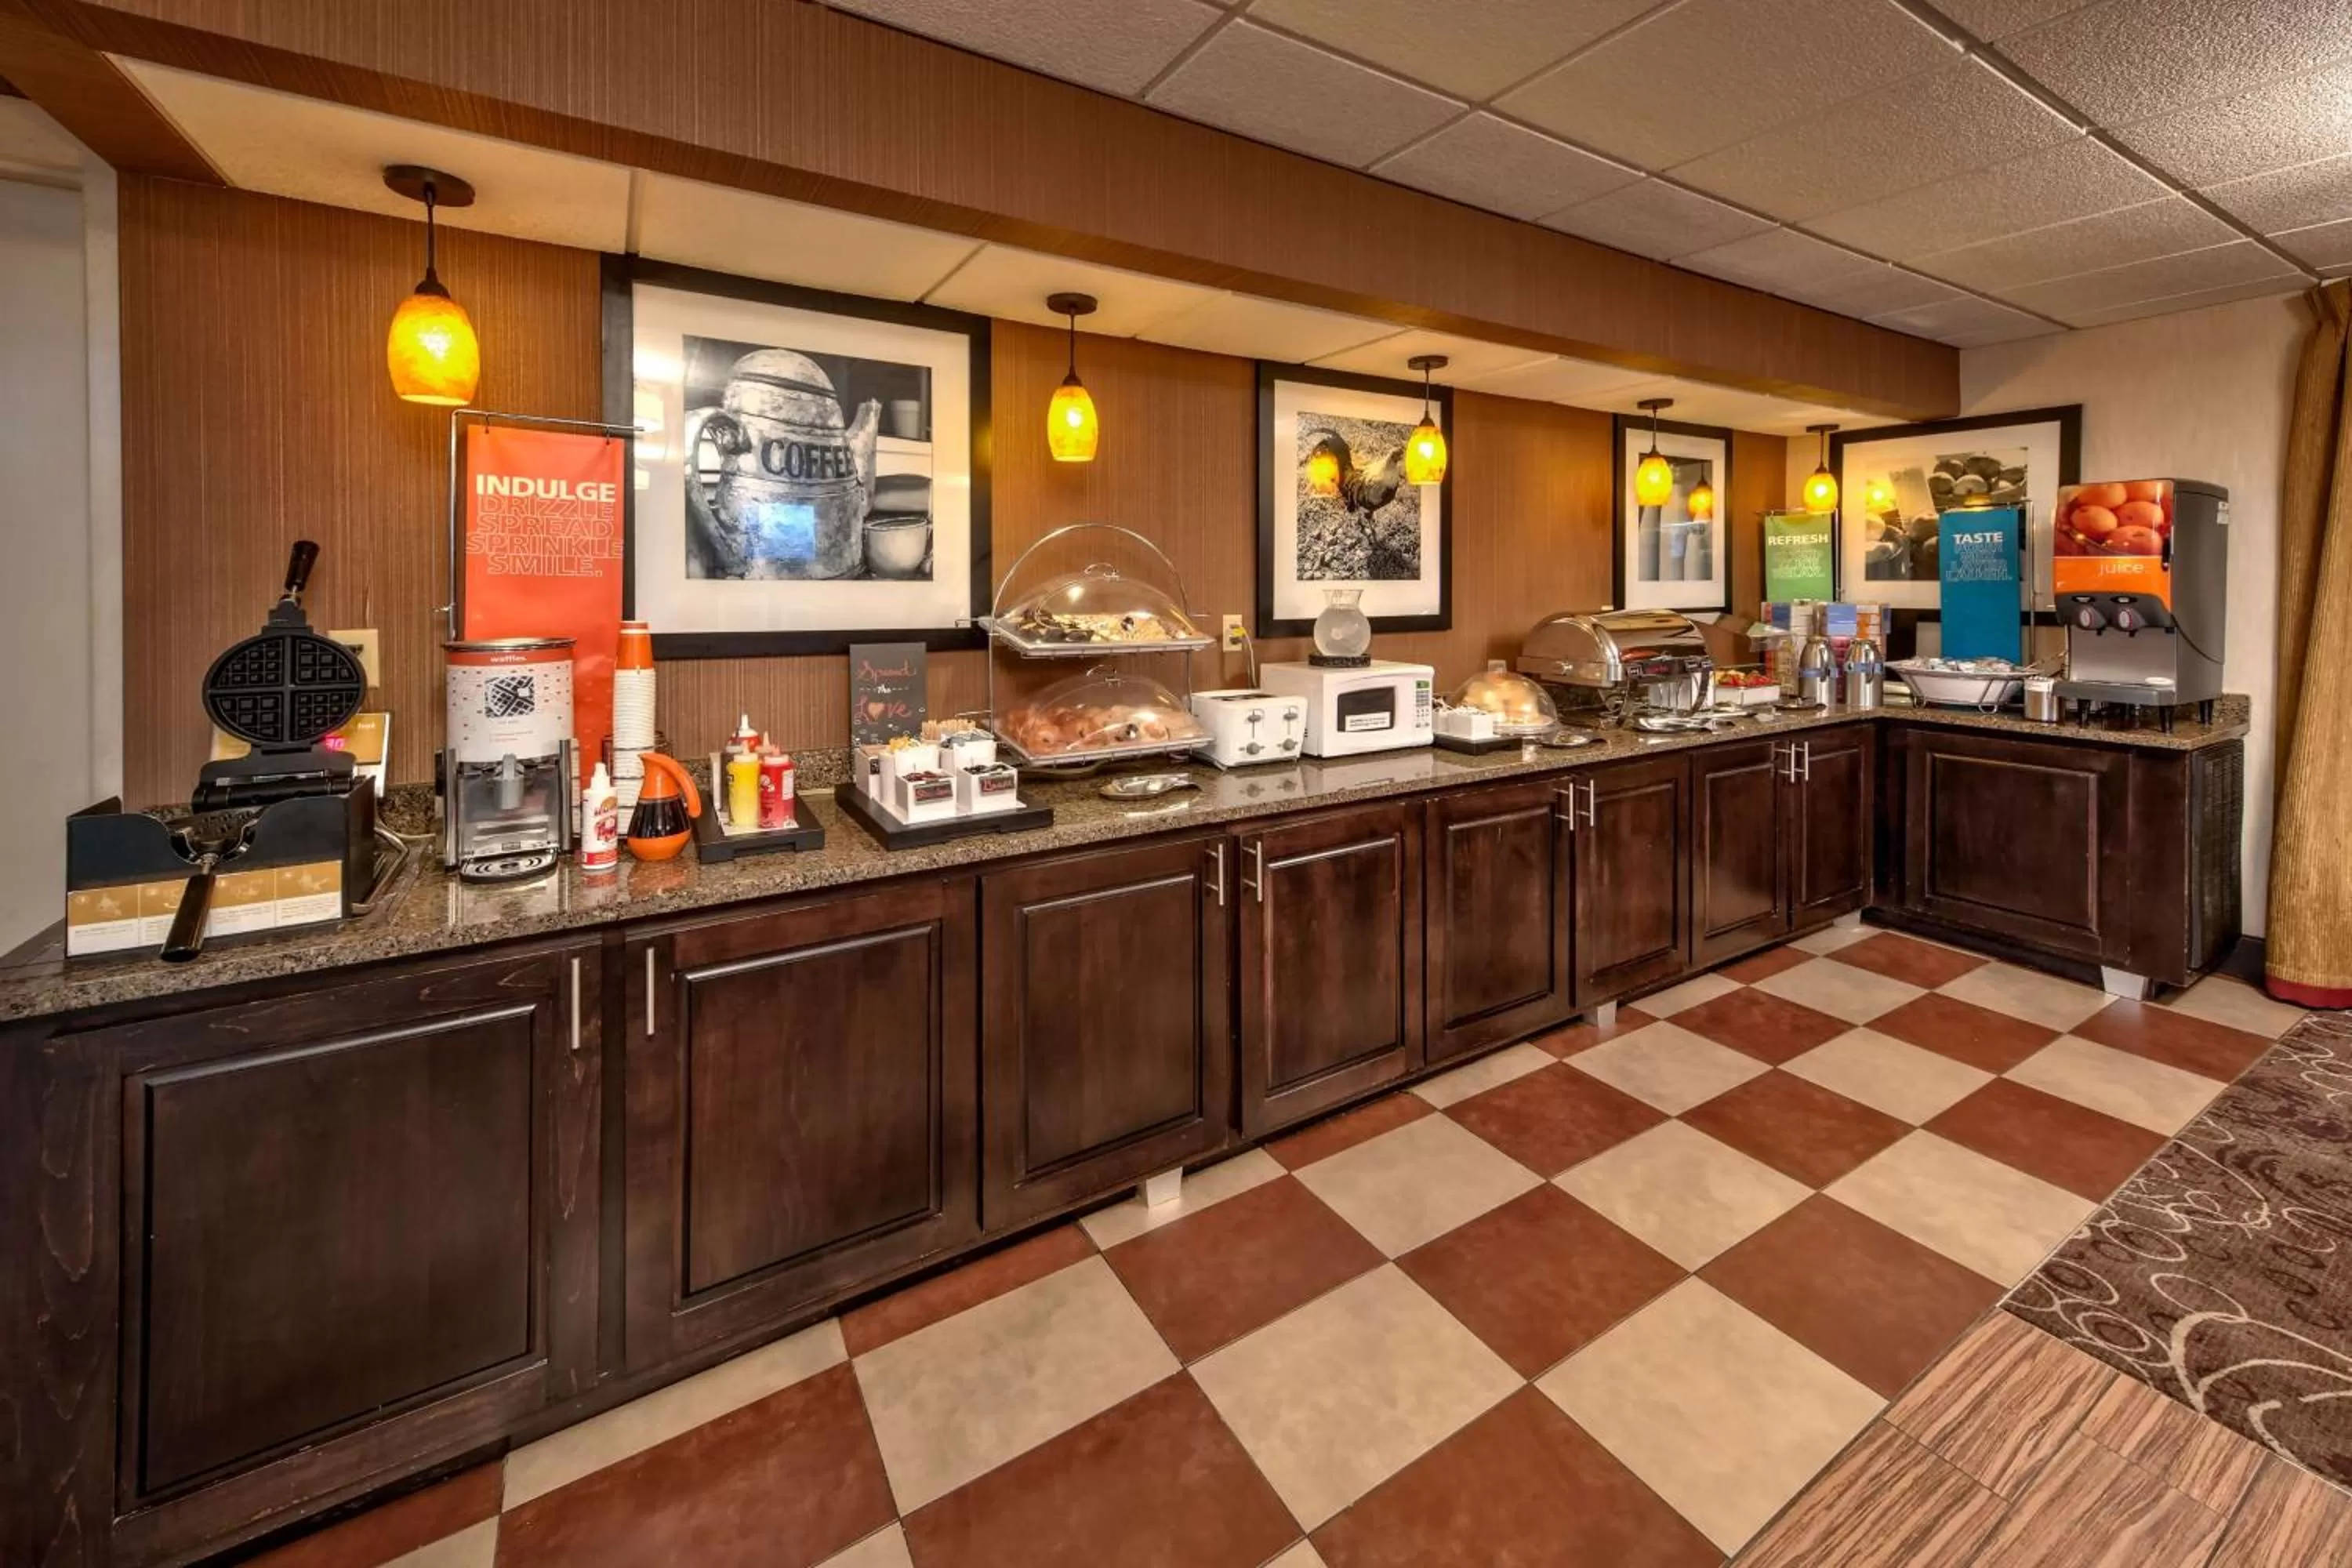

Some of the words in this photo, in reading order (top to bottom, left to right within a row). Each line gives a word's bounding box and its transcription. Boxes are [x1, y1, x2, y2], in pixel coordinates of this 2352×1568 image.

[760, 438, 856, 478] COFFEE
[475, 473, 616, 503] INDULGE
[477, 494, 615, 521] DRIZZLE
[477, 514, 615, 539] SPREAD
[1951, 531, 2004, 544] TASTE
[465, 532, 625, 559] SPRINKLE
[1767, 533, 1829, 546] REFRESH
[487, 554, 603, 577] SMILE.
[2098, 563, 2145, 577] juice
